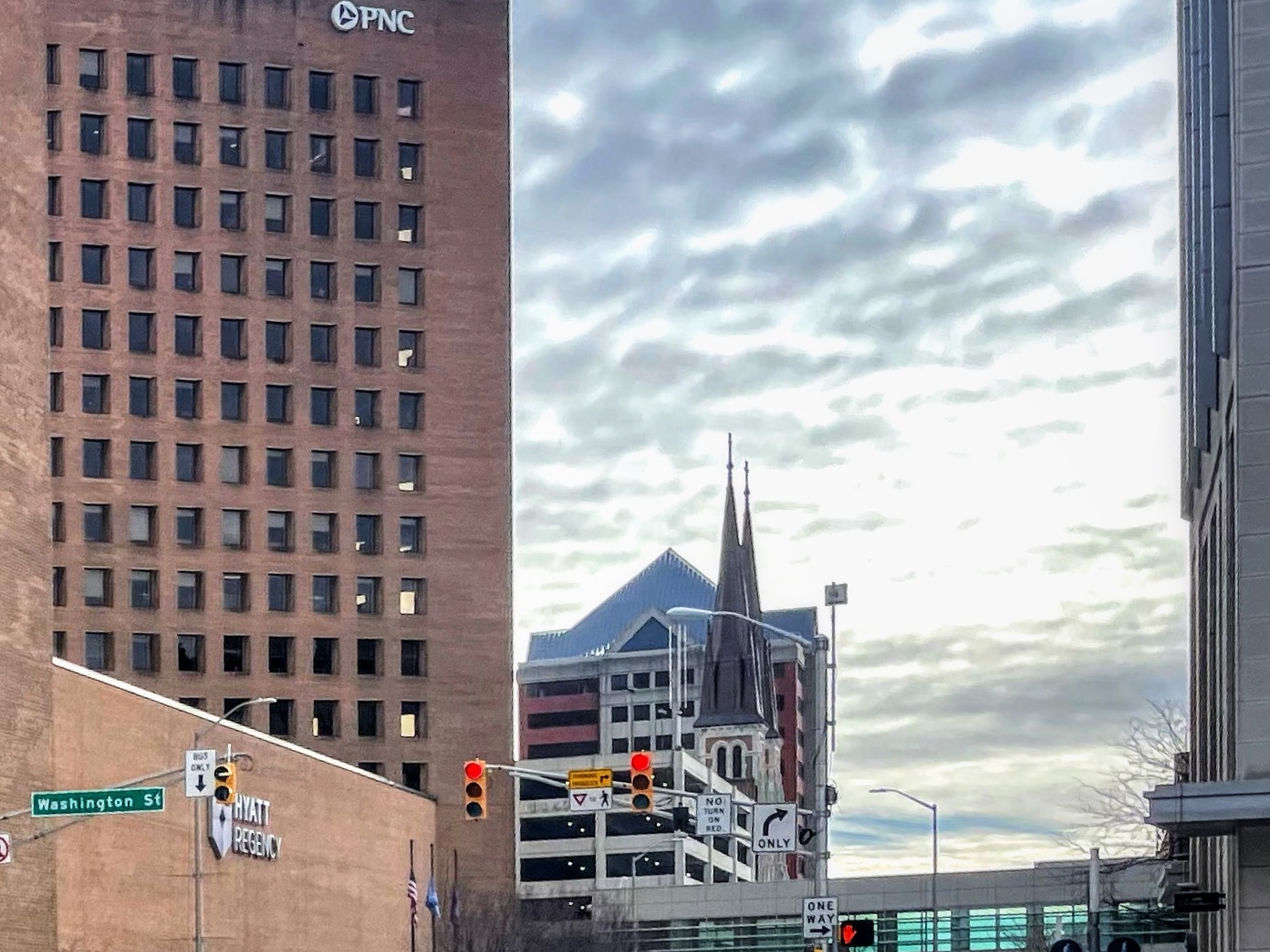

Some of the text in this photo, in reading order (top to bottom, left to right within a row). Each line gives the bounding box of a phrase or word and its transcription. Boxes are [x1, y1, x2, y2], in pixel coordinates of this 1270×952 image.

[359, 6, 415, 35] PNC
[191, 763, 210, 772] ONLY
[37, 793, 161, 811] Washington St
[706, 797, 722, 806] NO
[234, 793, 270, 826] HYATT
[234, 826, 282, 860] REGENCY
[758, 838, 790, 849] ONLY
[808, 901, 834, 911] ONE
[807, 914, 835, 924] WAY
